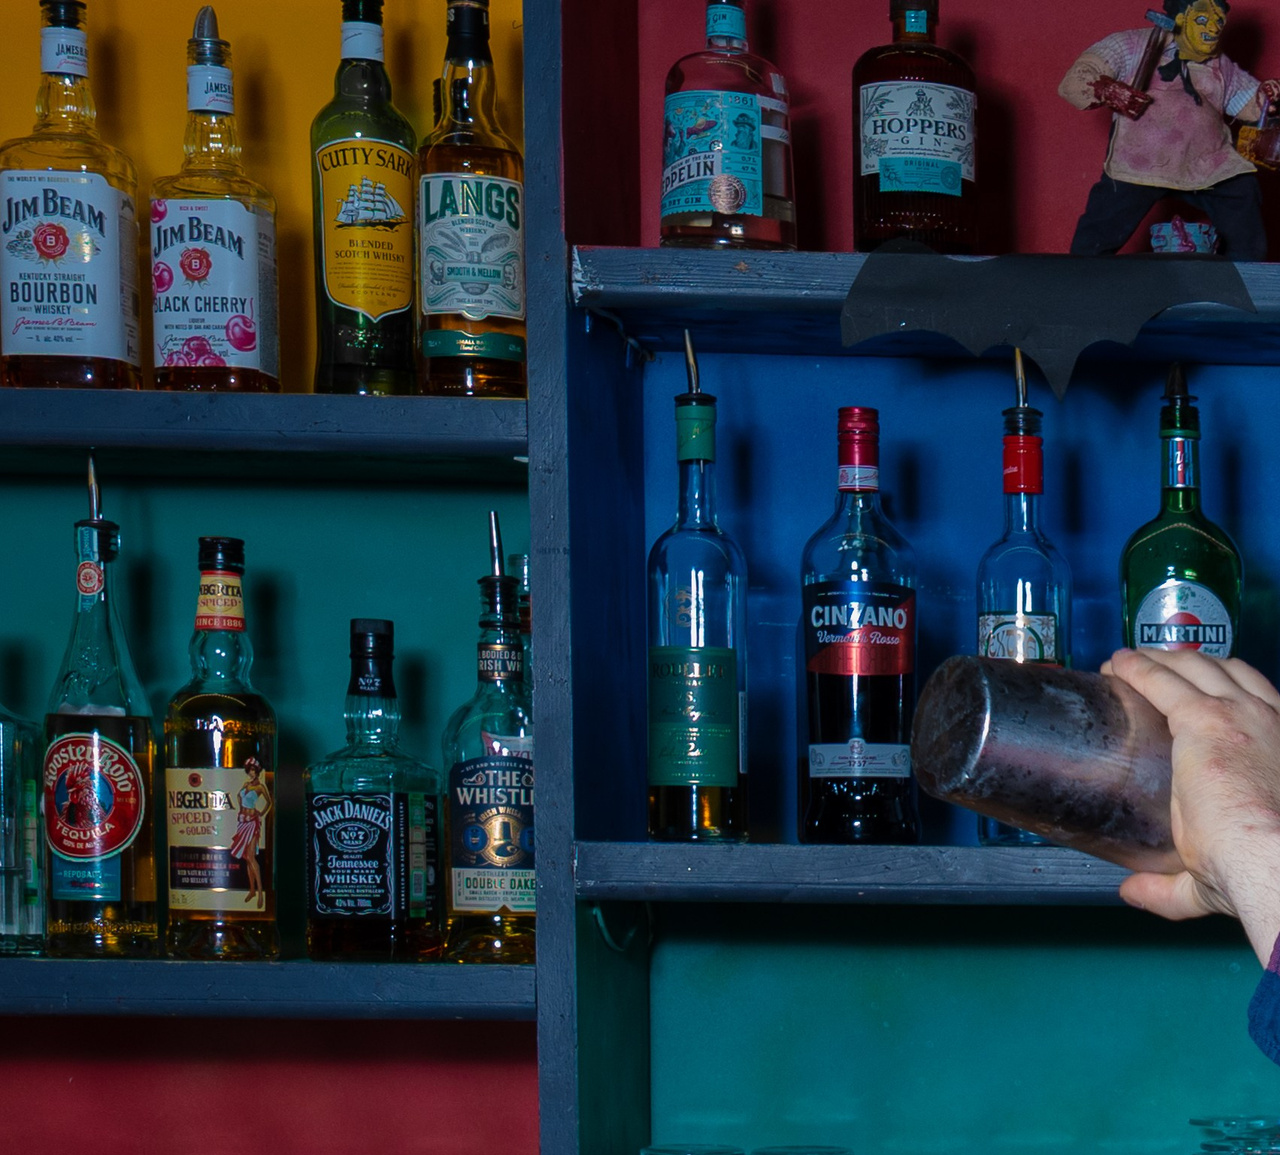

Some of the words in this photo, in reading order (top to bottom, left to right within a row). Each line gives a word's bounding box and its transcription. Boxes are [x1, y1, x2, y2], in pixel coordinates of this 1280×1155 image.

[712, 13, 727, 23] GIN
[55, 43, 80, 56] JAMES
[204, 82, 227, 94] JAMES
[872, 117, 966, 141] HOPPERS
[321, 147, 374, 172] CUTTY
[375, 149, 413, 180] SARK
[904, 160, 940, 168] ORIGINAL
[424, 180, 520, 231] LANGS
[2, 196, 40, 235] JIM
[42, 188, 106, 238] BEAM
[154, 223, 185, 258] JIM
[188, 216, 244, 260] BEAM
[349, 239, 394, 251] BLENDED
[335, 251, 370, 260] SCOTCH
[373, 252, 405, 263] WHISKY
[19, 273, 52, 281] KENTUCKY
[54, 273, 86, 282] STRAIGHT
[447, 266, 471, 277] SMOOTH
[472, 267, 477, 276] &
[477, 268, 501, 279] MELLOW
[10, 282, 97, 304] BOURBON
[34, 305, 72, 315] WHISKEY
[195, 296, 247, 314] CHERRY
[200, 598, 238, 607] SPICED
[811, 601, 907, 629] CINZANO
[817, 630, 868, 643] Vermouth
[870, 632, 900, 645] Rosso
[1143, 626, 1224, 642] MARTINI
[482, 650, 510, 660] BODIED
[485, 770, 521, 786] THE
[168, 790, 236, 810] NEGRITA
[456, 787, 534, 805] WHISTL
[171, 812, 212, 825] SPICED
[313, 804, 344, 829] JACK
[344, 800, 392, 830] DANIEL'S
[478, 807, 497, 822] IRISH
[56, 822, 115, 841] TEQUILA
[186, 825, 217, 836] GOLDEN
[328, 855, 379, 869] Tennessee
[324, 874, 382, 884] WHISKEY
[464, 877, 506, 889] DOUBLE
